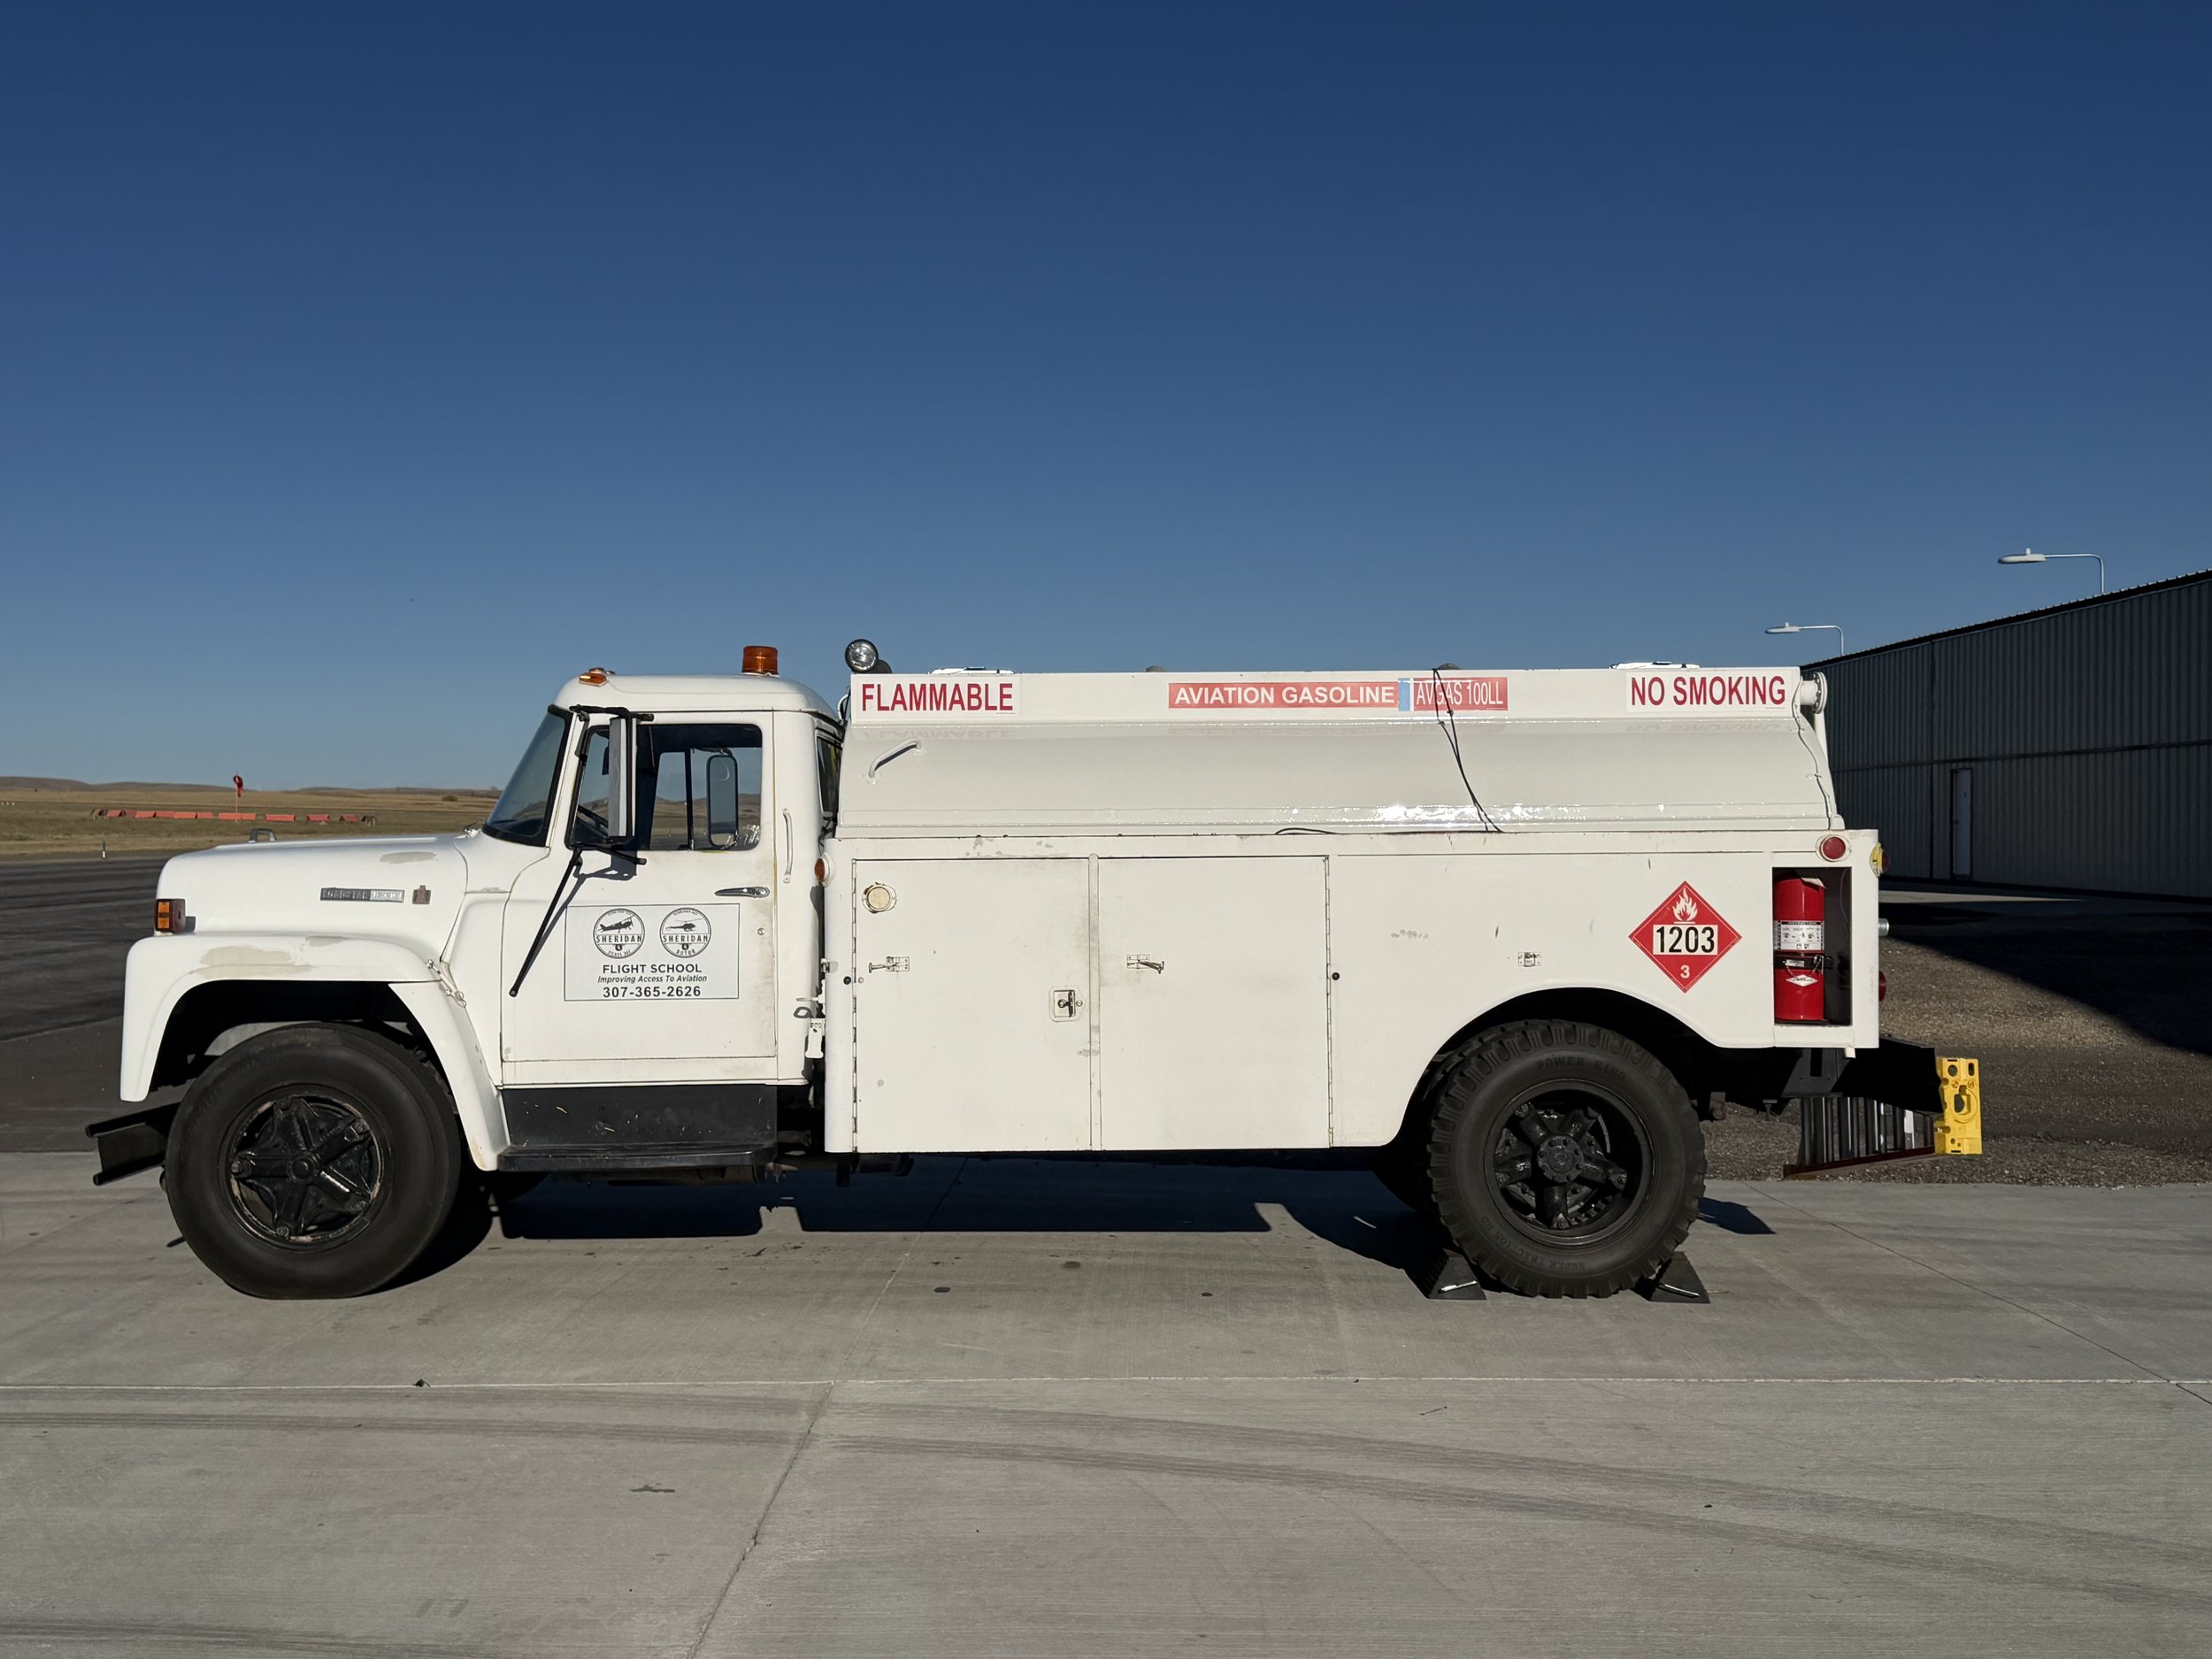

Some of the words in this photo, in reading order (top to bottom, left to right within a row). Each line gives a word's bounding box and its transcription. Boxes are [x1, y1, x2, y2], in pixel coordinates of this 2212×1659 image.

[862, 683, 1014, 711] FLAMMABLE
[1175, 687, 1274, 704] AVIATION
[1281, 686, 1395, 704] GASOLINE
[1417, 680, 1463, 705] AVGAS
[1466, 680, 1504, 705] 100LL
[1631, 676, 1665, 706] NO
[1672, 675, 1786, 706] SMOKING
[596, 934, 642, 943] SHERIDAN
[663, 934, 709, 943] SHERIDAN
[1655, 926, 1716, 953] 1203
[603, 964, 647, 973] FLIGHT
[650, 964, 703, 973] SCHOOL
[1680, 964, 1691, 979] 3
[597, 975, 636, 984] Improving
[603, 986, 702, 997] 307-365-2626
[1536, 1056, 1585, 1071] POWER
